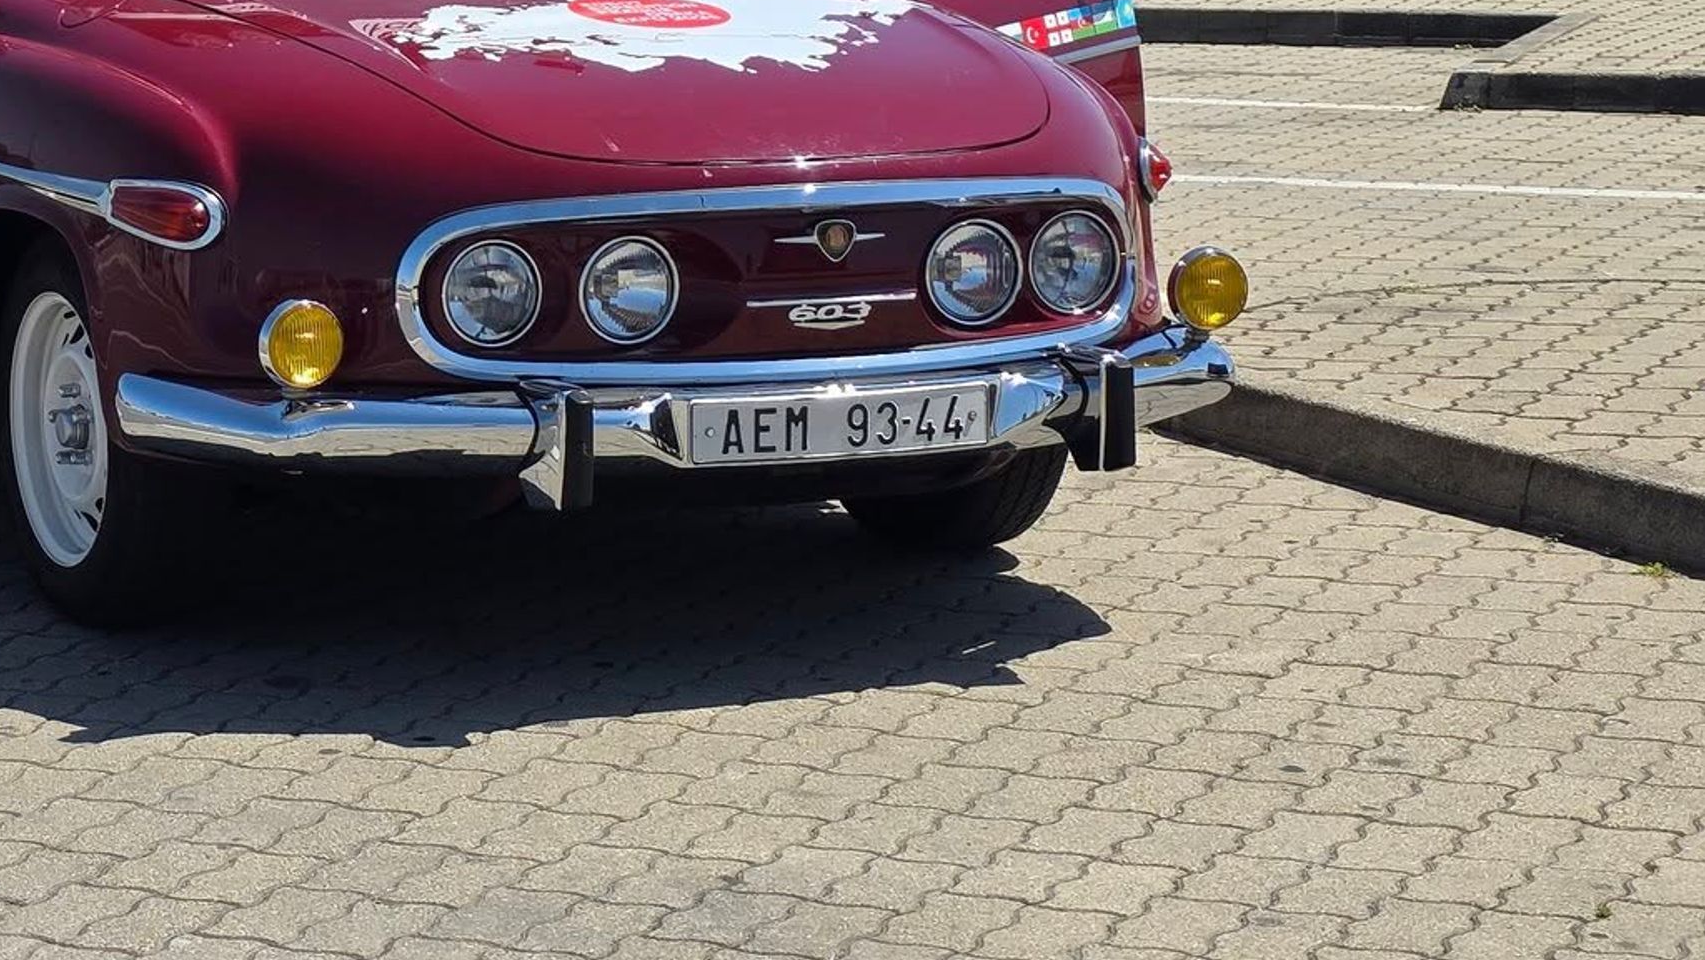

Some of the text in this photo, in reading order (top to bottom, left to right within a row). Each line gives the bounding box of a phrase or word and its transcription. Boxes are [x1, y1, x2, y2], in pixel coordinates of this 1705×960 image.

[788, 300, 872, 322] 603
[721, 394, 964, 455] AEM 93-44
